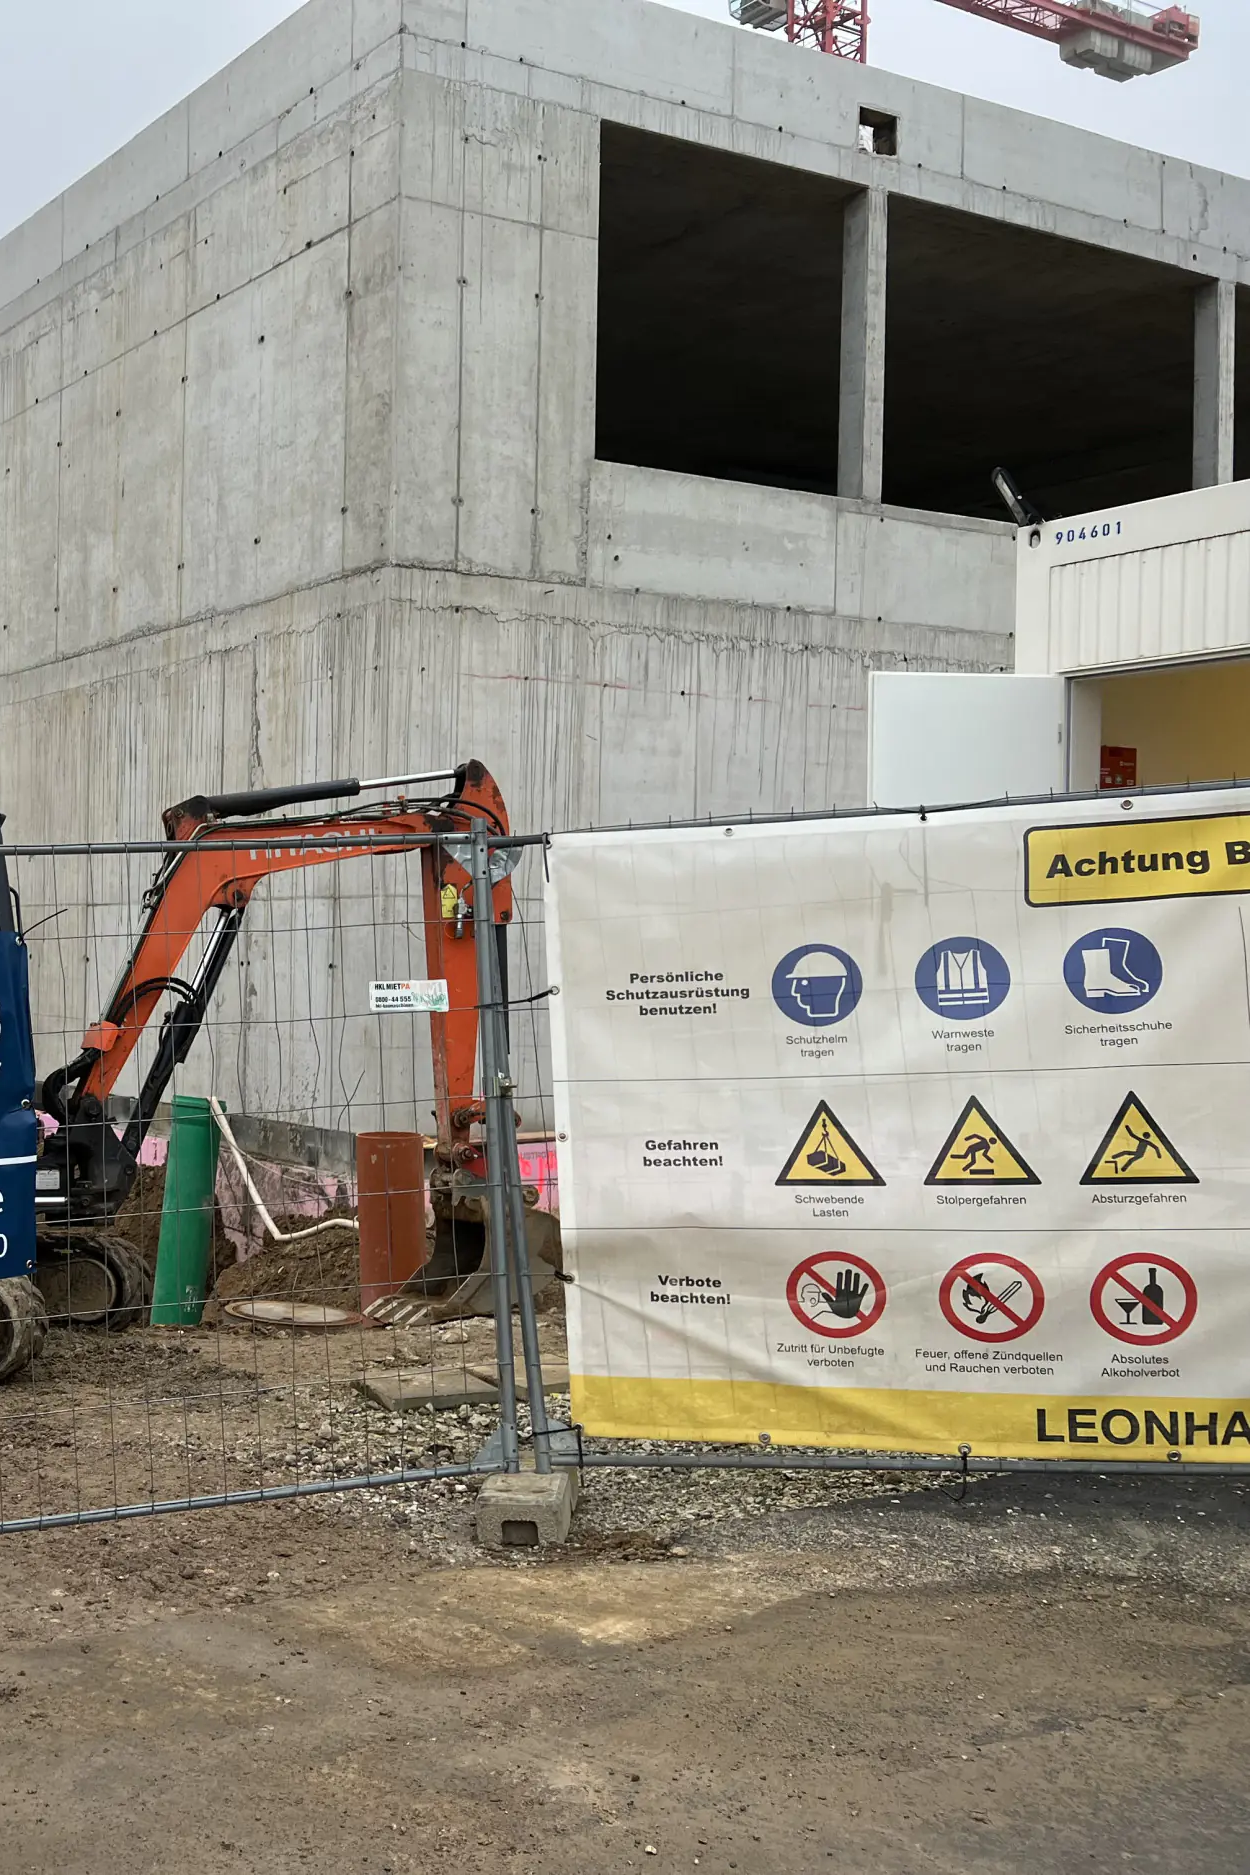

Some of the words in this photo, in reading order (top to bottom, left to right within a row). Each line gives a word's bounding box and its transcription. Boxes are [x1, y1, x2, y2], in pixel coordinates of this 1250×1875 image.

[1055, 521, 1121, 545] 904601
[1046, 849, 1210, 879] Achtung
[1225, 840, 1250, 866] B
[629, 970, 724, 984] Persönliche
[605, 987, 750, 1001] Schutzausrüstung
[639, 1003, 717, 1016] benutzen!
[1065, 1020, 1173, 1034] Sicherheitsschuhe
[785, 1034, 848, 1045] Schutzhelm
[931, 1027, 995, 1040] Warnweste
[946, 1042, 982, 1053] tragen
[1100, 1037, 1138, 1047] tragen
[800, 1048, 835, 1058] tragen
[645, 1140, 719, 1150] Gefahren
[643, 1156, 723, 1167] beachten!
[795, 1194, 865, 1204] Schwebende
[936, 1195, 1027, 1206] Stolpergefahren
[1092, 1193, 1187, 1205] Absturzgefahren
[813, 1208, 849, 1217] Lasten
[658, 1275, 722, 1288] Verbote
[650, 1291, 730, 1304] beachten!
[777, 1343, 807, 1352] Zutritt
[810, 1344, 825, 1353] für
[829, 1345, 885, 1357] Unbefugte
[915, 1349, 950, 1360] Feuer,
[954, 1350, 989, 1360] offene
[993, 1351, 1063, 1362] Zündquellen
[807, 1359, 854, 1367] verboten
[1111, 1354, 1169, 1364] Absolutes
[926, 1363, 946, 1372] und
[950, 1363, 1000, 1373] Rauchen
[1003, 1365, 1054, 1375] verboten
[1101, 1368, 1180, 1377] Alkoholverbot
[1037, 1408, 1250, 1446] LEONHA
